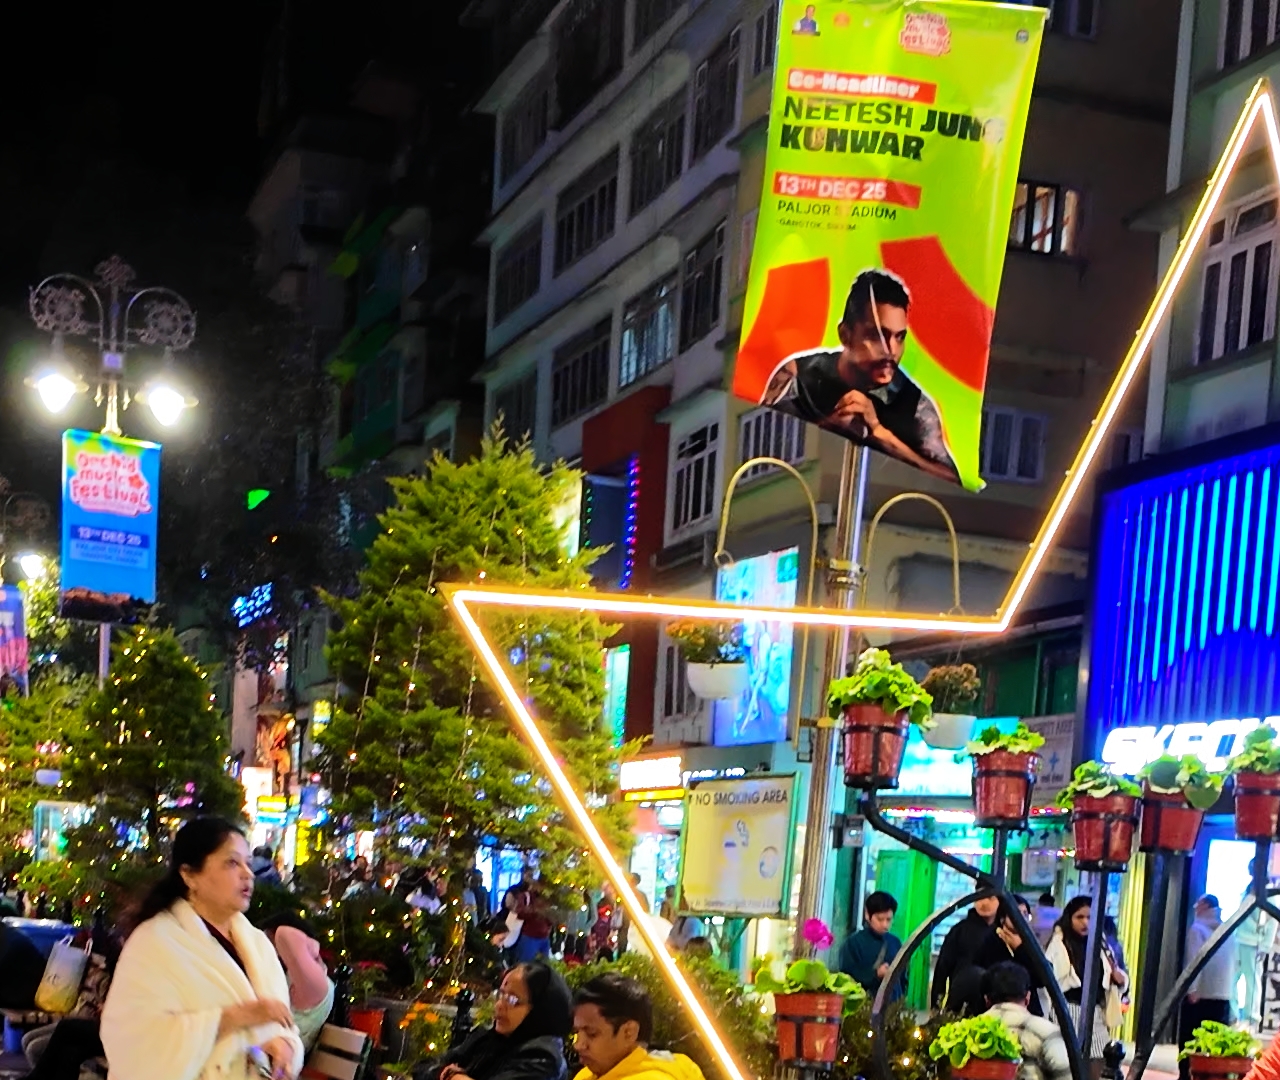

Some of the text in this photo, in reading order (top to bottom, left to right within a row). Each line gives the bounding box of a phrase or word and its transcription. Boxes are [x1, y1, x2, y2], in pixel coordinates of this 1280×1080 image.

[789, 70, 920, 99] Co-Headliner
[784, 96, 914, 128] NEETESH
[780, 124, 925, 161] KUNWAR
[818, 180, 861, 199] DEC
[861, 181, 888, 200] 25
[777, 200, 897, 221] PALJOR SADIUM
[695, 788, 788, 806] NO SMOKING AREA
